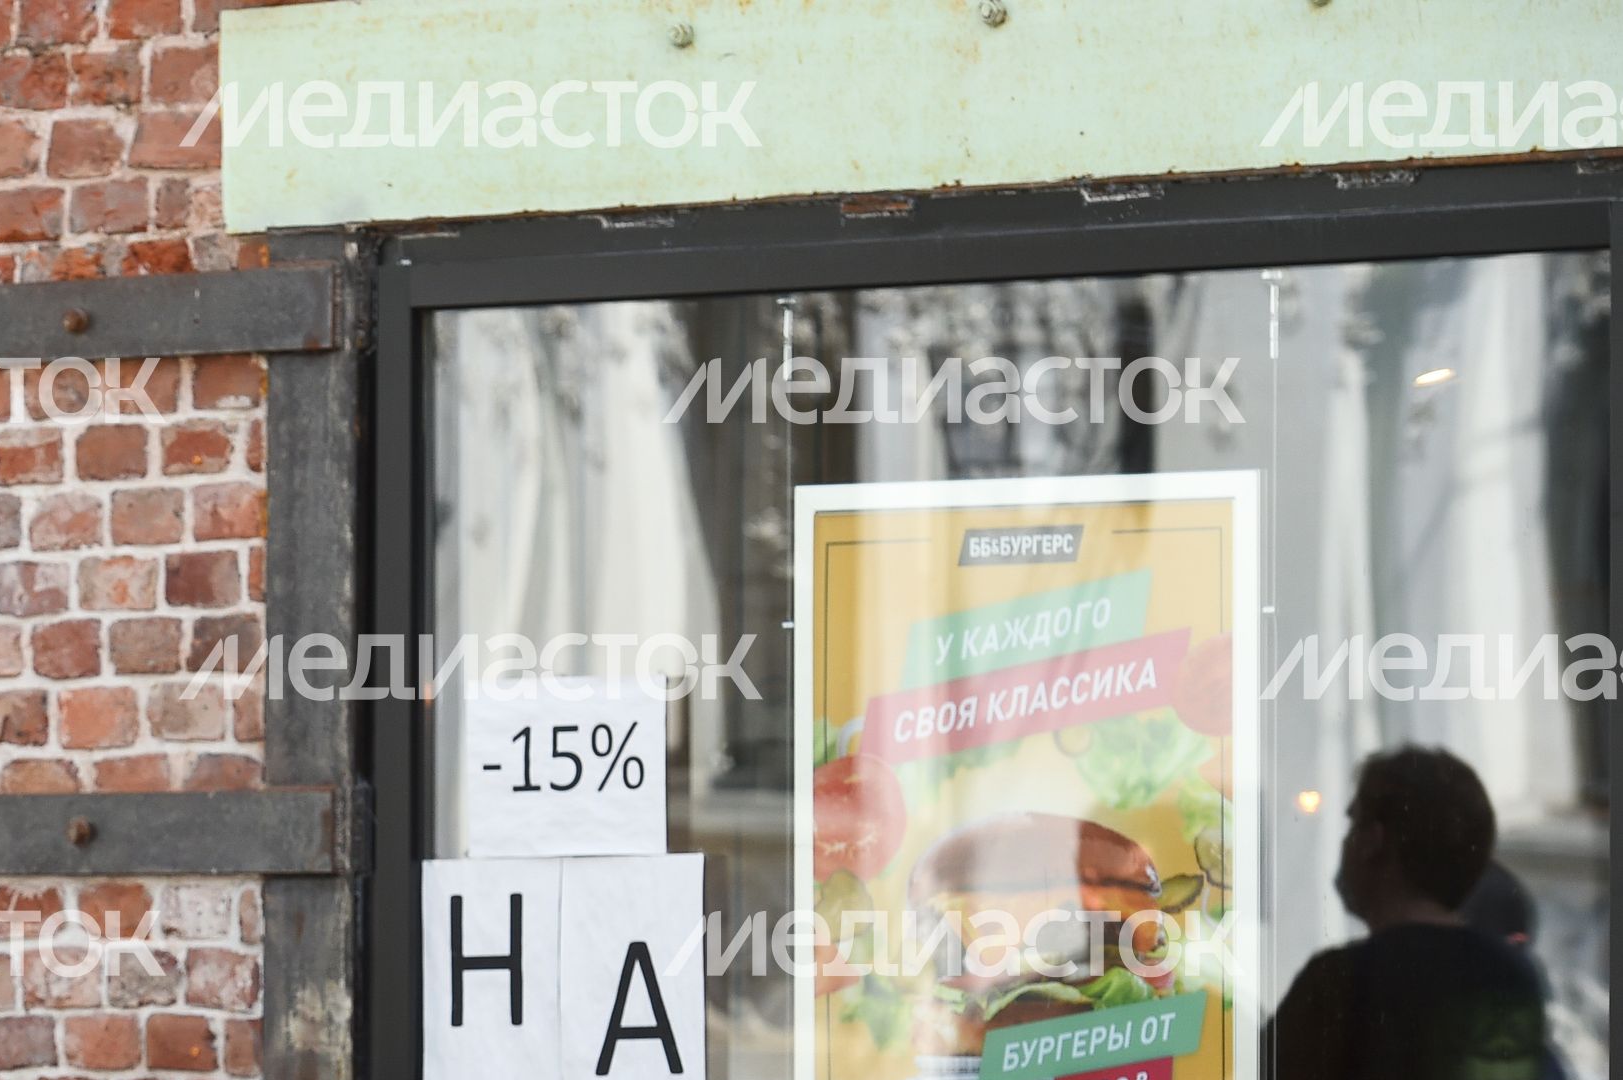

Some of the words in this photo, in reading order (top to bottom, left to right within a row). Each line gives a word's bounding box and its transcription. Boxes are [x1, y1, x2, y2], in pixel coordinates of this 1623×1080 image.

[969, 533, 1074, 558] ББ&БУРГЕРС
[934, 633, 954, 666] У
[960, 597, 1113, 661] КАЖДОГО
[893, 696, 978, 744] СВОЯ
[985, 658, 1158, 725] КЛАССИКА
[482, 721, 645, 792] -15%
[450, 893, 684, 1077] НА
[1002, 1021, 1132, 1073] БУРГЕРЫ
[1140, 1013, 1176, 1045] ОТ
